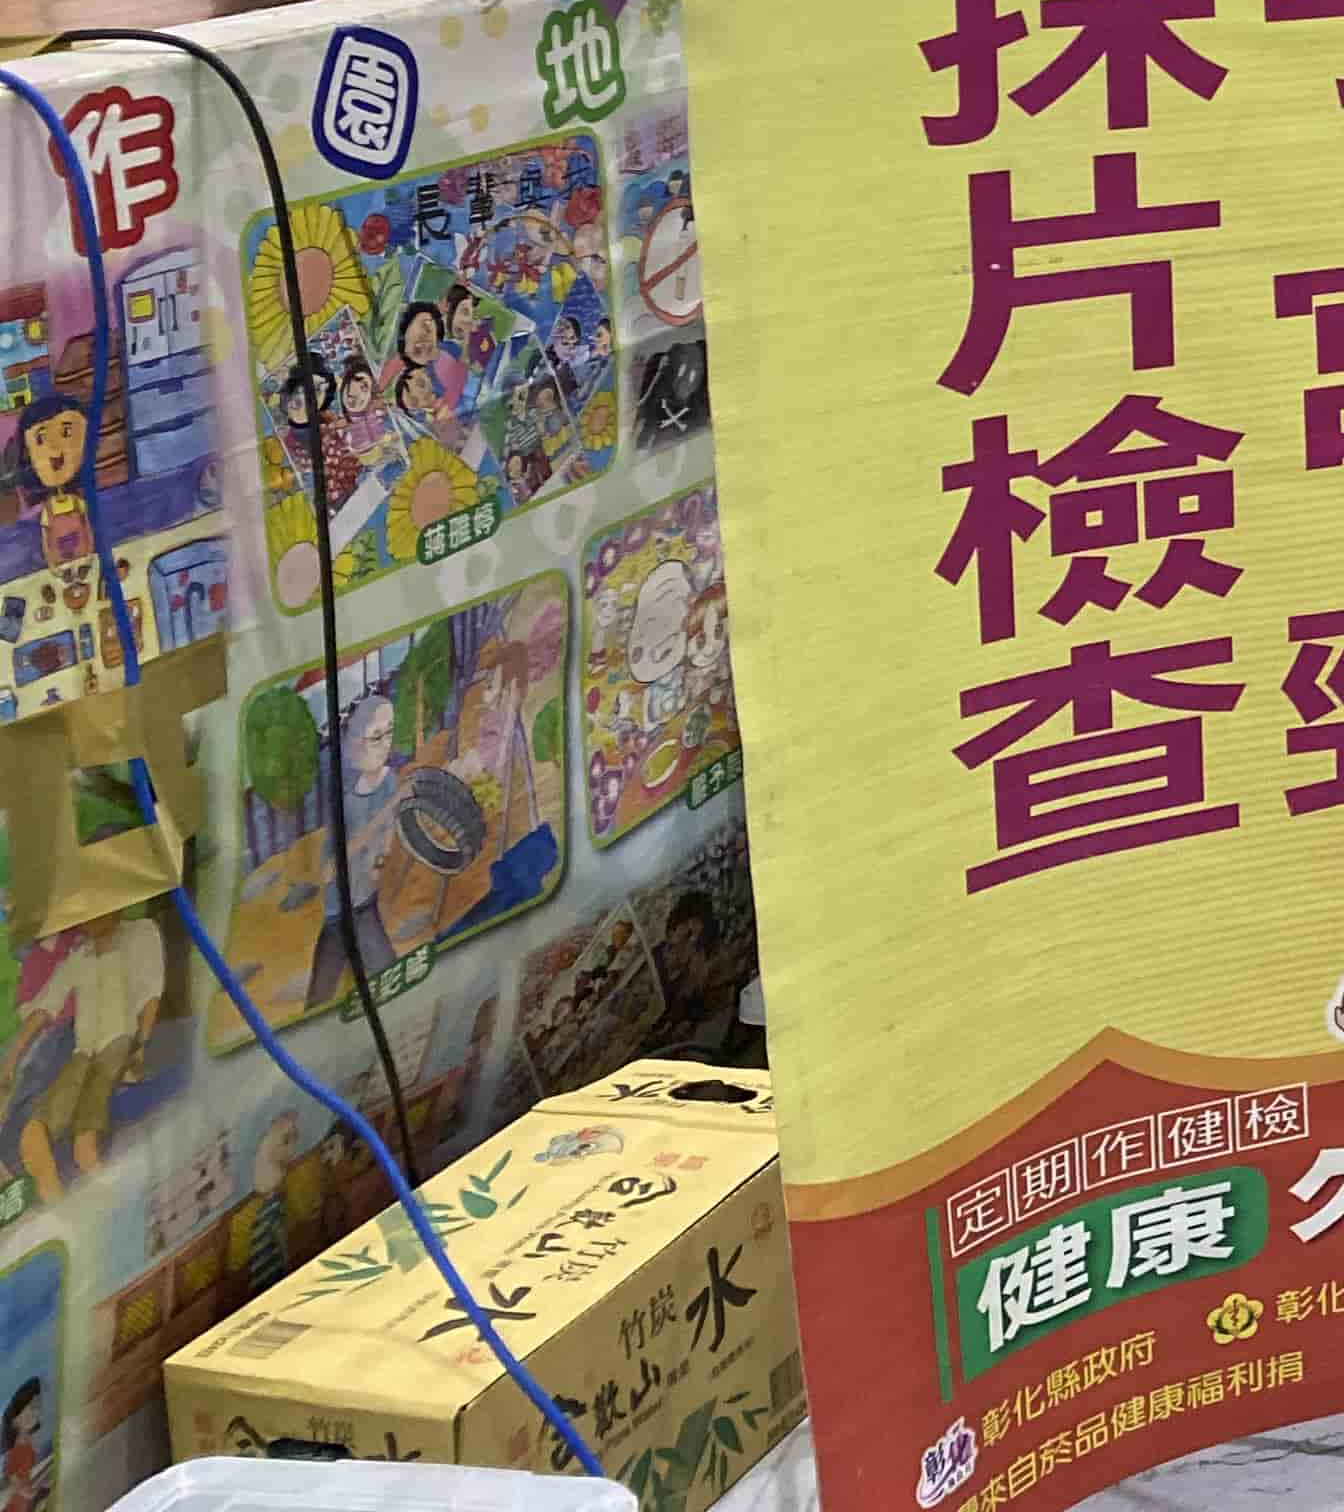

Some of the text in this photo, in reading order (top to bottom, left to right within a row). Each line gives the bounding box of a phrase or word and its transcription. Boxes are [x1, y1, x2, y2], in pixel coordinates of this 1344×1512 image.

[956, 1091, 1302, 1247] 定期作健檢
[684, 1243, 758, 1354] 水
[976, 1179, 1236, 1352] 健康
[979, 1330, 1157, 1449] 彰化縣政府
